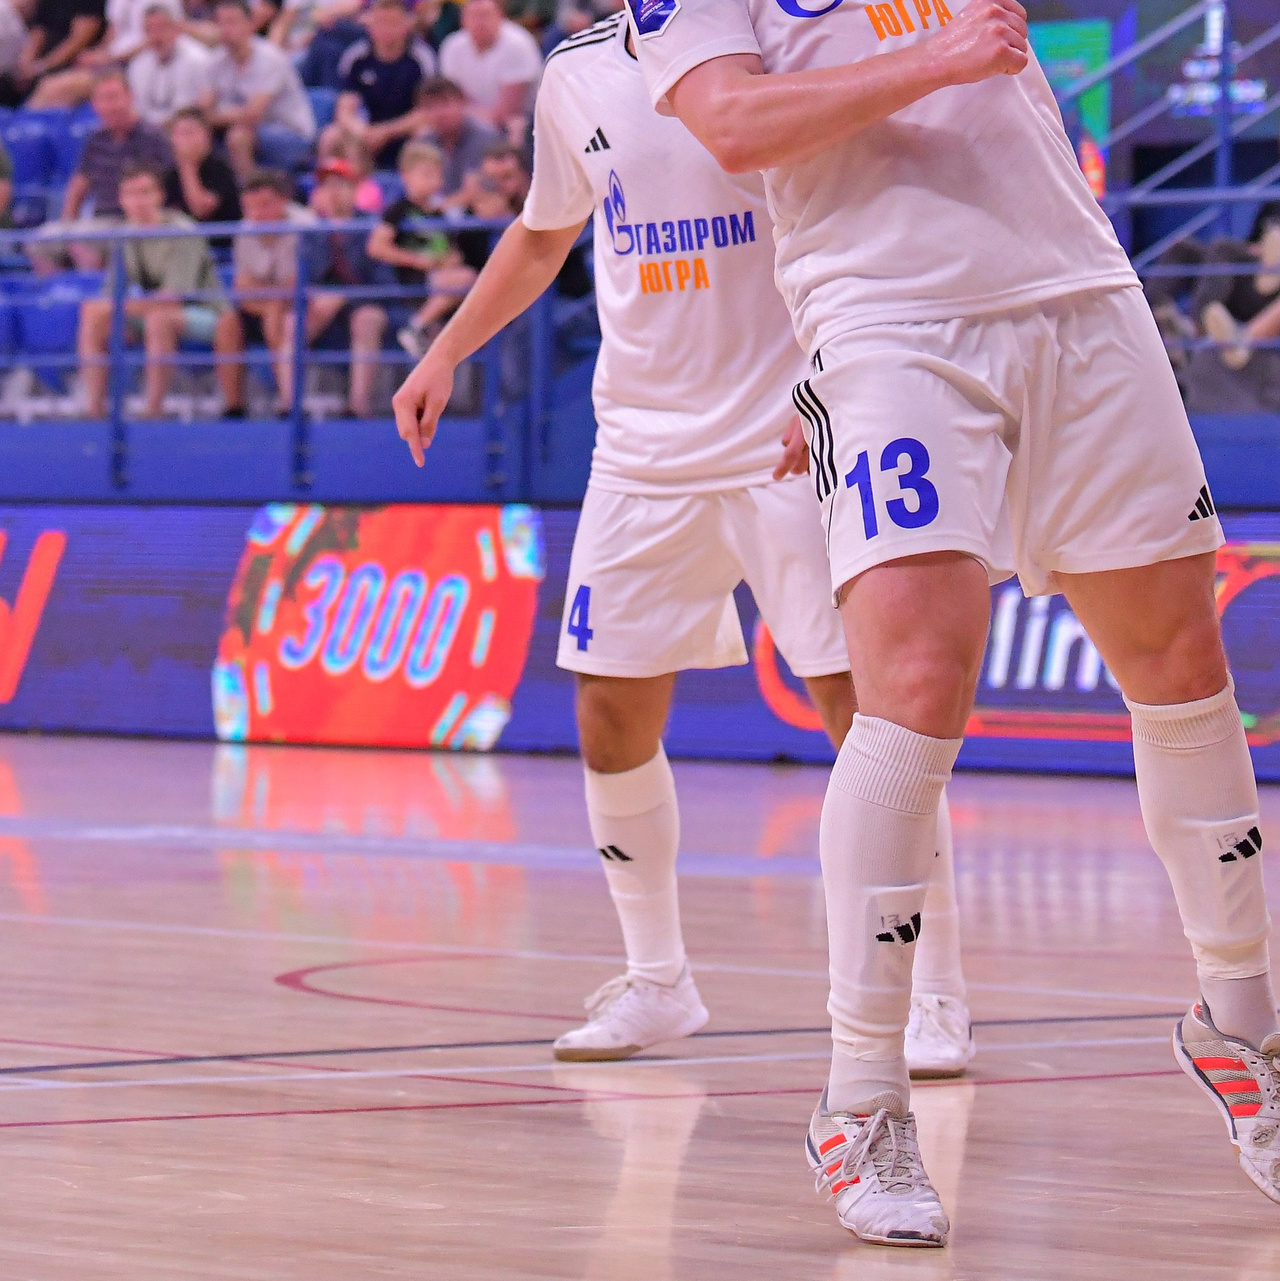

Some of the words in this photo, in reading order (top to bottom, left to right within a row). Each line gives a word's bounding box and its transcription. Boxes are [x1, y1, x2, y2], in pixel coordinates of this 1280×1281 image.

[635, 211, 756, 255] ГАЗПРОМ
[639, 258, 710, 294] ЮГРА
[845, 437, 939, 540] 13
[279, 556, 470, 688] 3000
[567, 584, 593, 652] 4
[880, 914, 901, 928] 13
